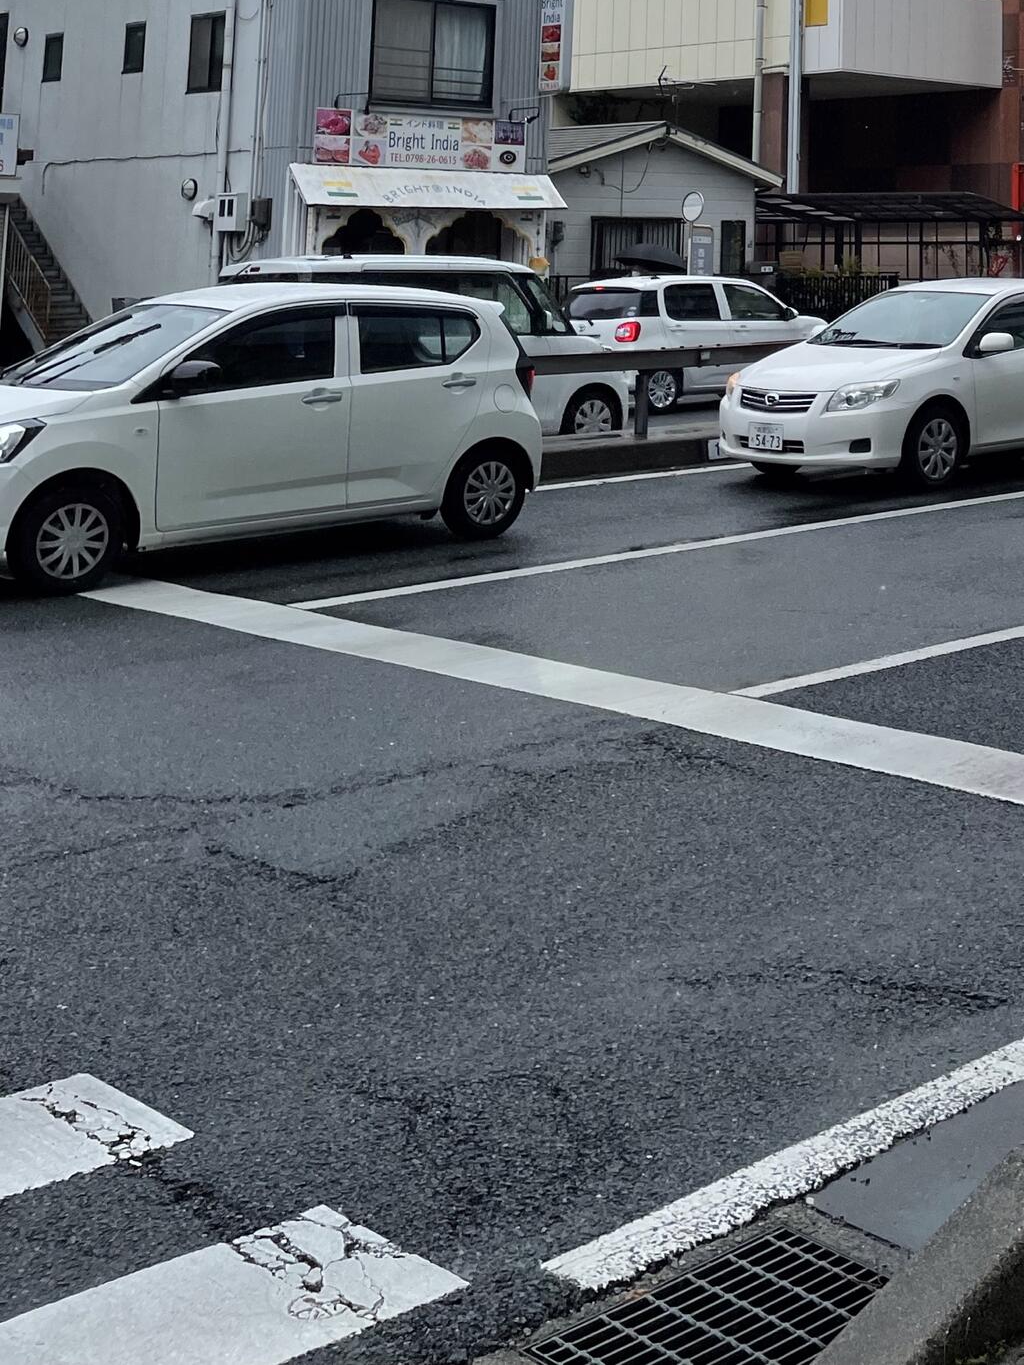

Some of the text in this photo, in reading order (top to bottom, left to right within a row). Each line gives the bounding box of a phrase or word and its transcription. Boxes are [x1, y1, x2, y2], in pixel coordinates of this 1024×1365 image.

[543, 12, 561, 23] India
[388, 131, 459, 152] Bright India
[755, 434, 781, 448] 54-73
